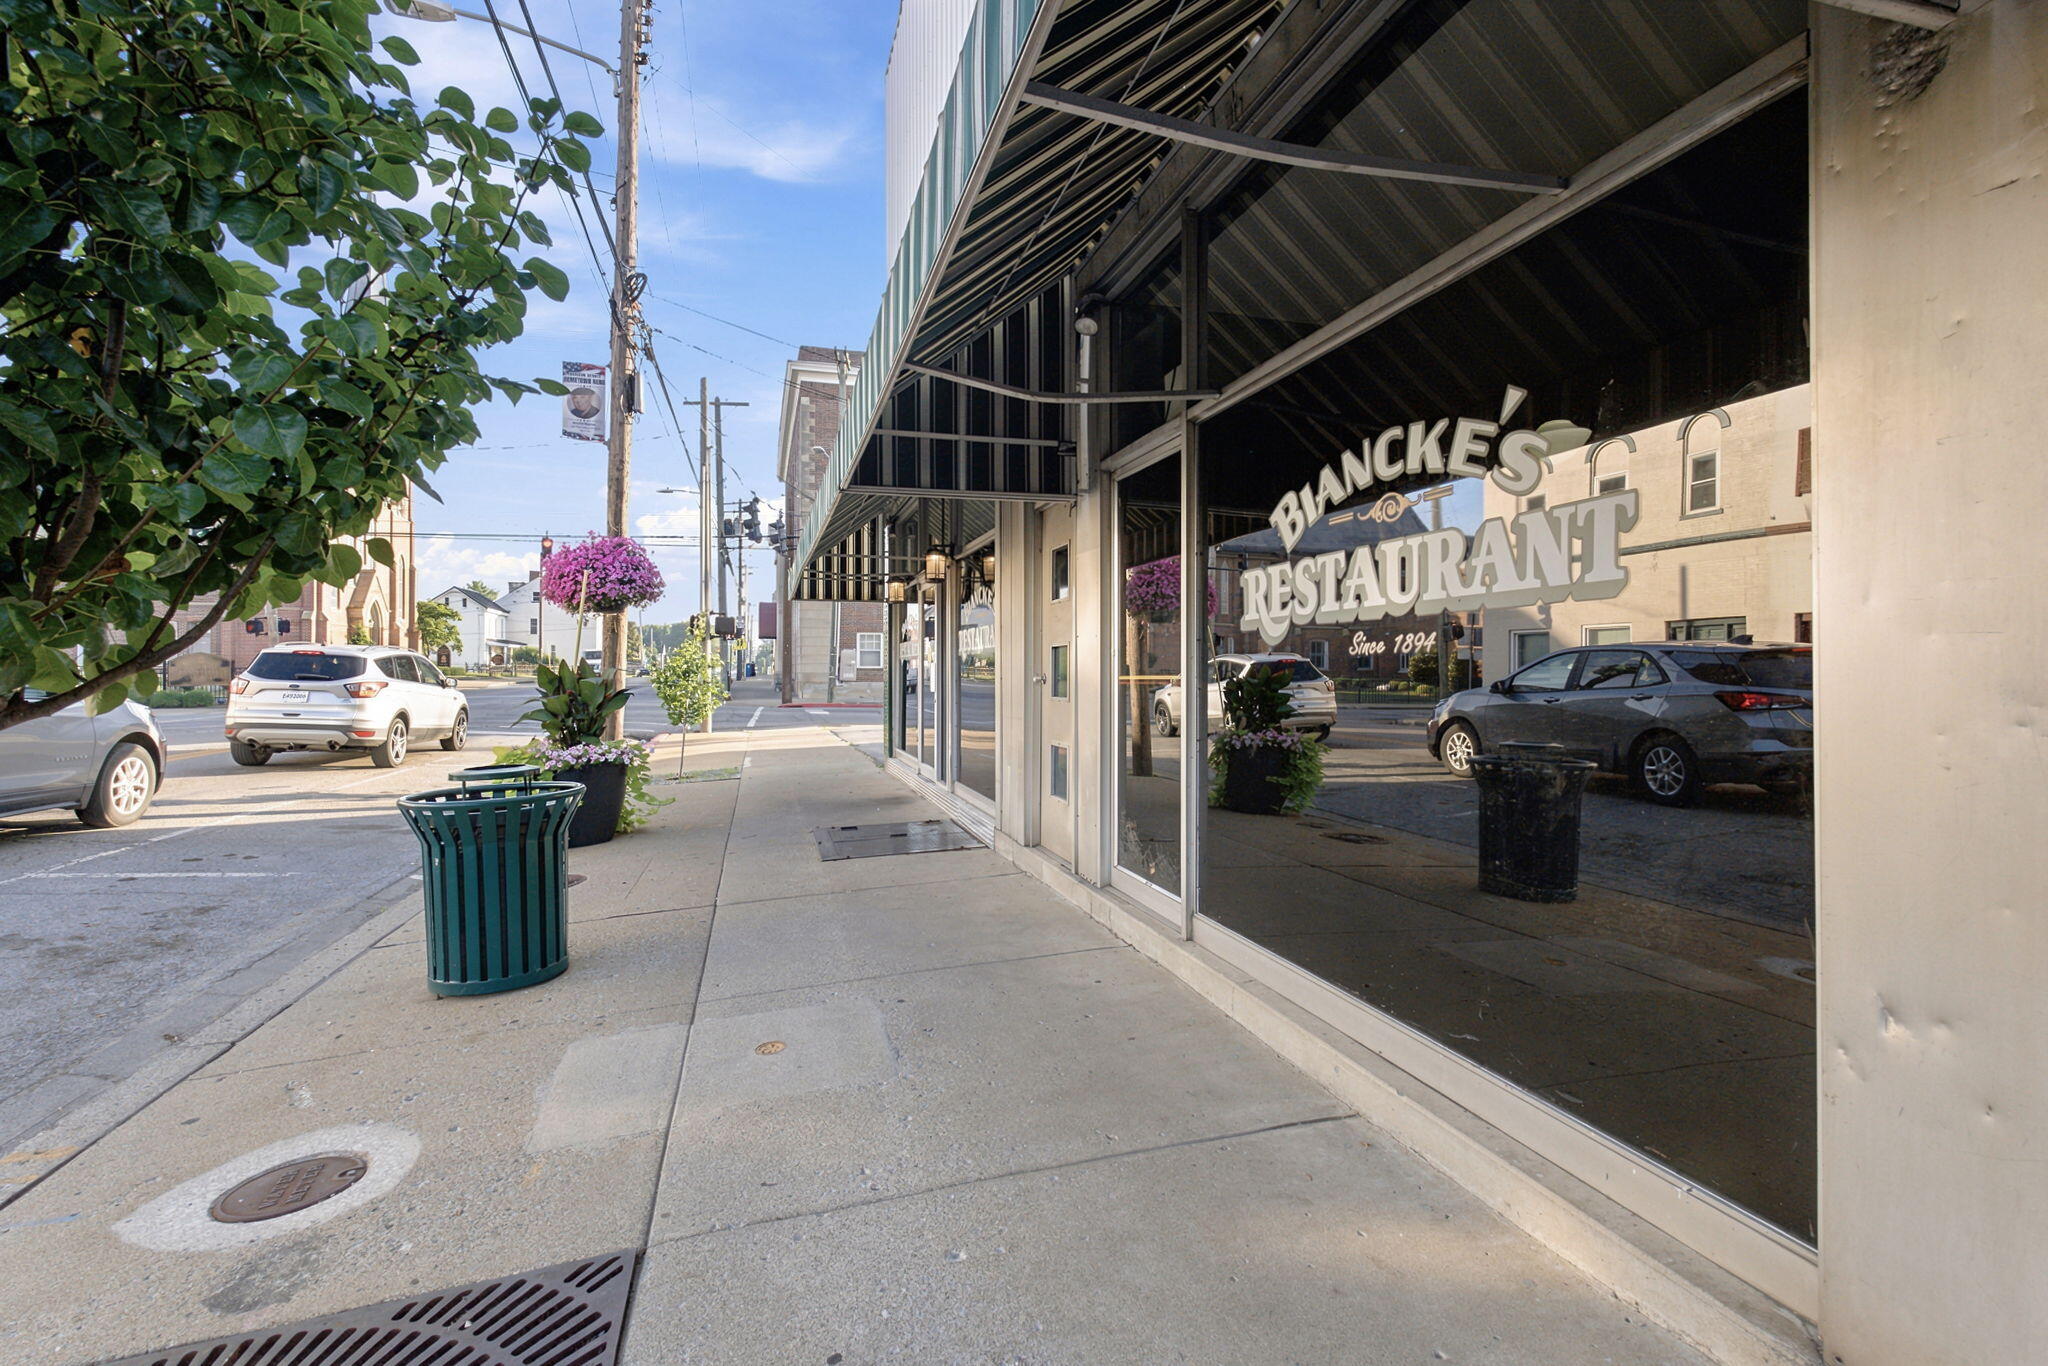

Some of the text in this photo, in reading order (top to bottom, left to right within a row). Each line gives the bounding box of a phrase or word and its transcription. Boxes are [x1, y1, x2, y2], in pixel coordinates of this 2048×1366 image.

[1269, 384, 1550, 552] BIANCKE'S
[1240, 488, 1639, 647] RESTAURANT
[1349, 631, 1437, 656] Since 1894
